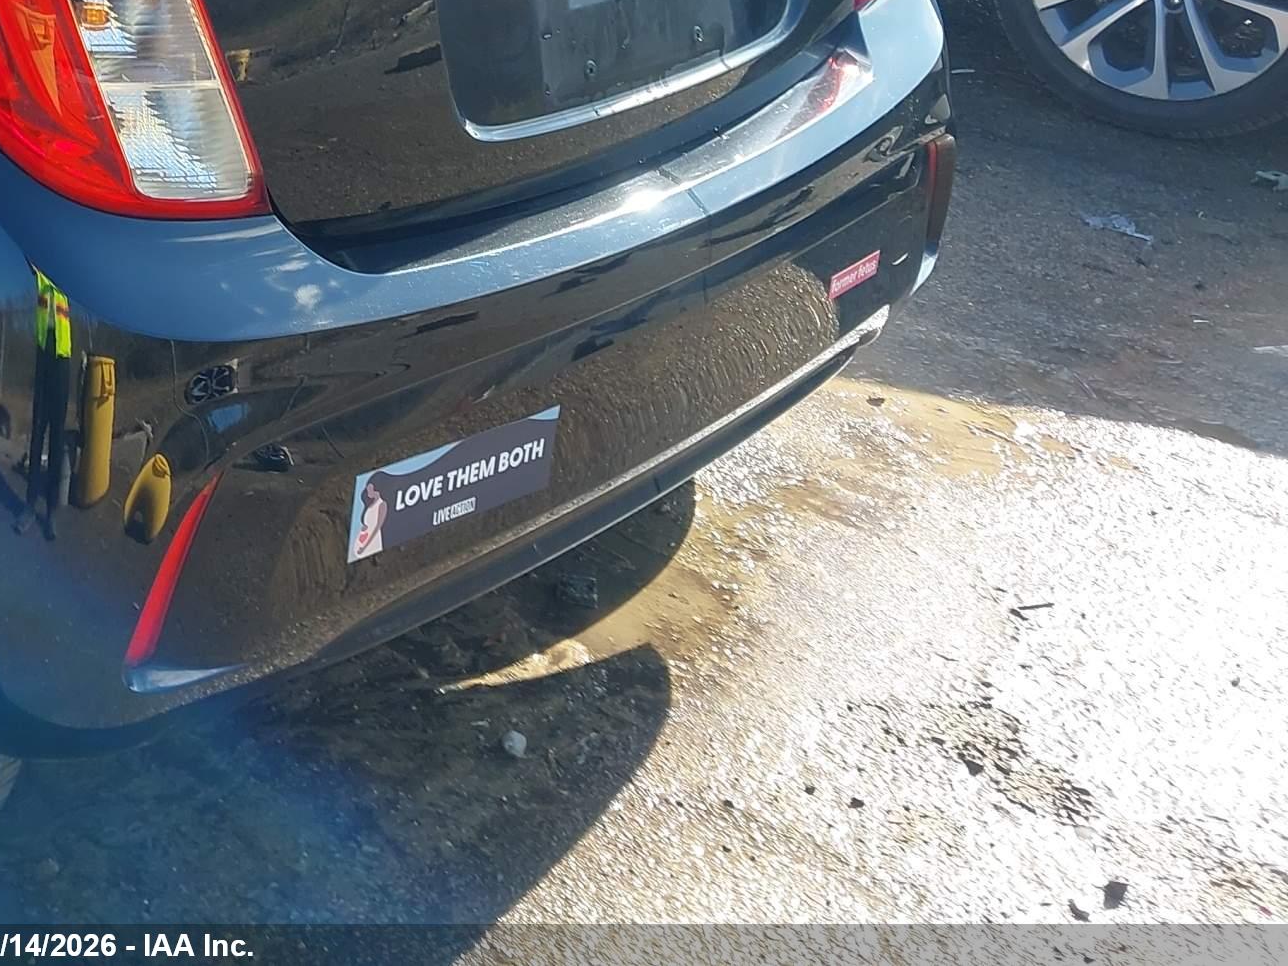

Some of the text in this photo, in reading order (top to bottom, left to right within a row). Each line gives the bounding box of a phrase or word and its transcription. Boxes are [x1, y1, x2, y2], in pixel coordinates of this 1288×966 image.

[395, 437, 546, 512] LOVE THEM BOTH
